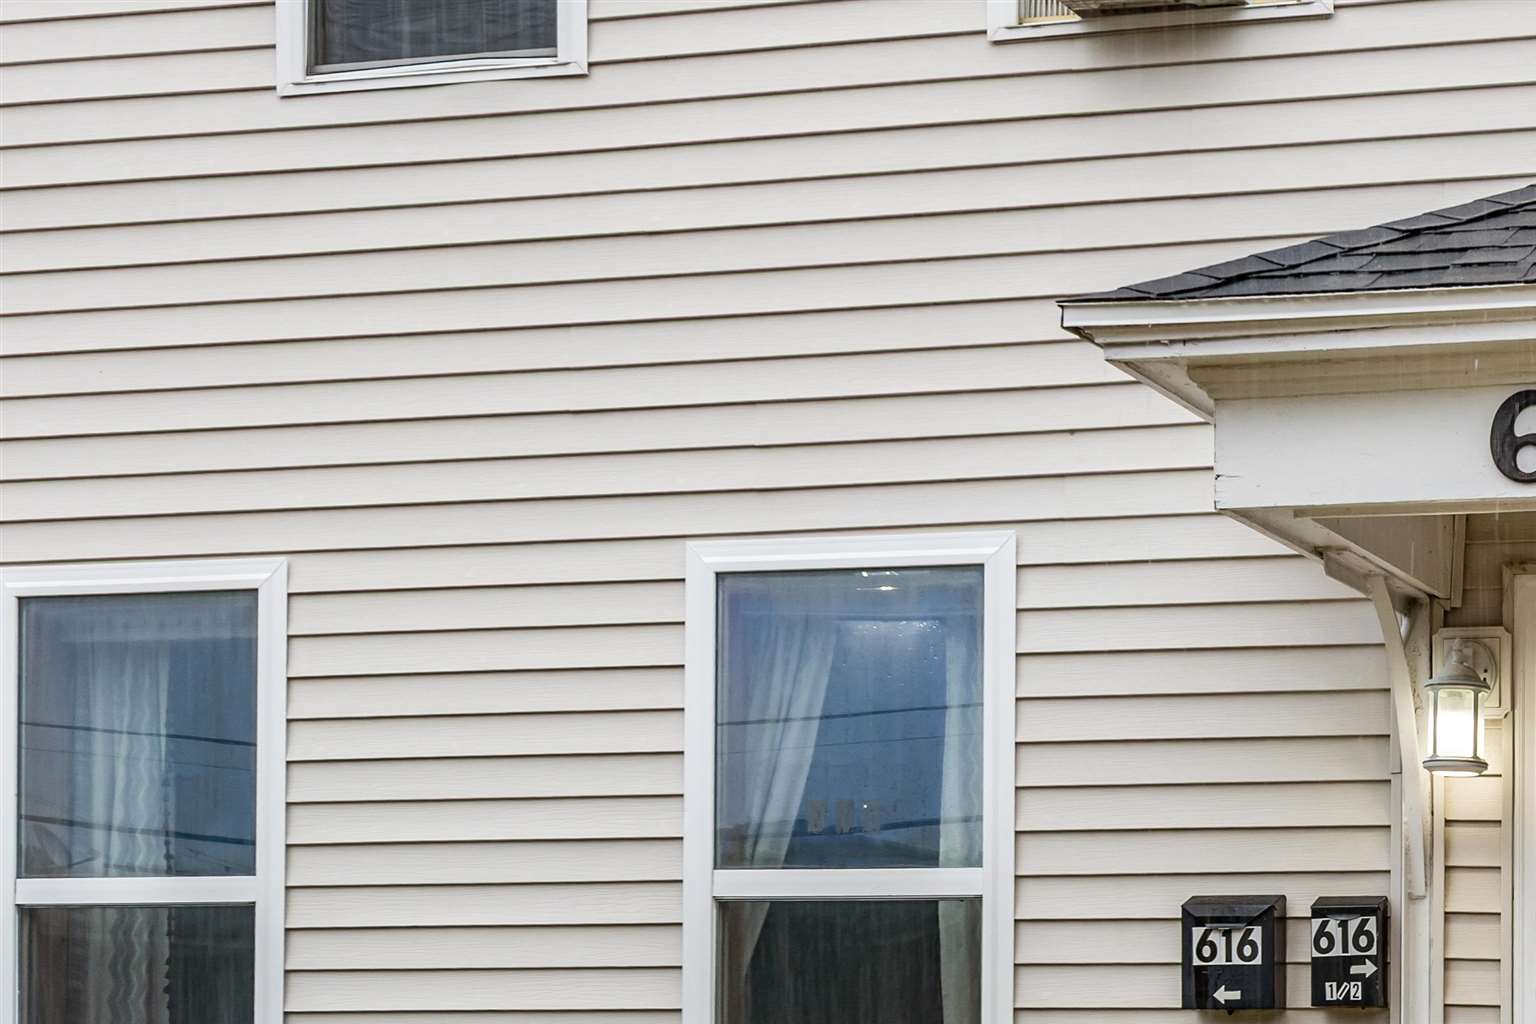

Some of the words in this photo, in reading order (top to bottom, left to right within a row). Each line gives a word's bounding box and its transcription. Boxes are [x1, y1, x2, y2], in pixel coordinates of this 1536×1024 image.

[1195, 927, 1259, 963] 616
[1312, 918, 1375, 955] 616
[1328, 982, 1360, 1000] 1/2
